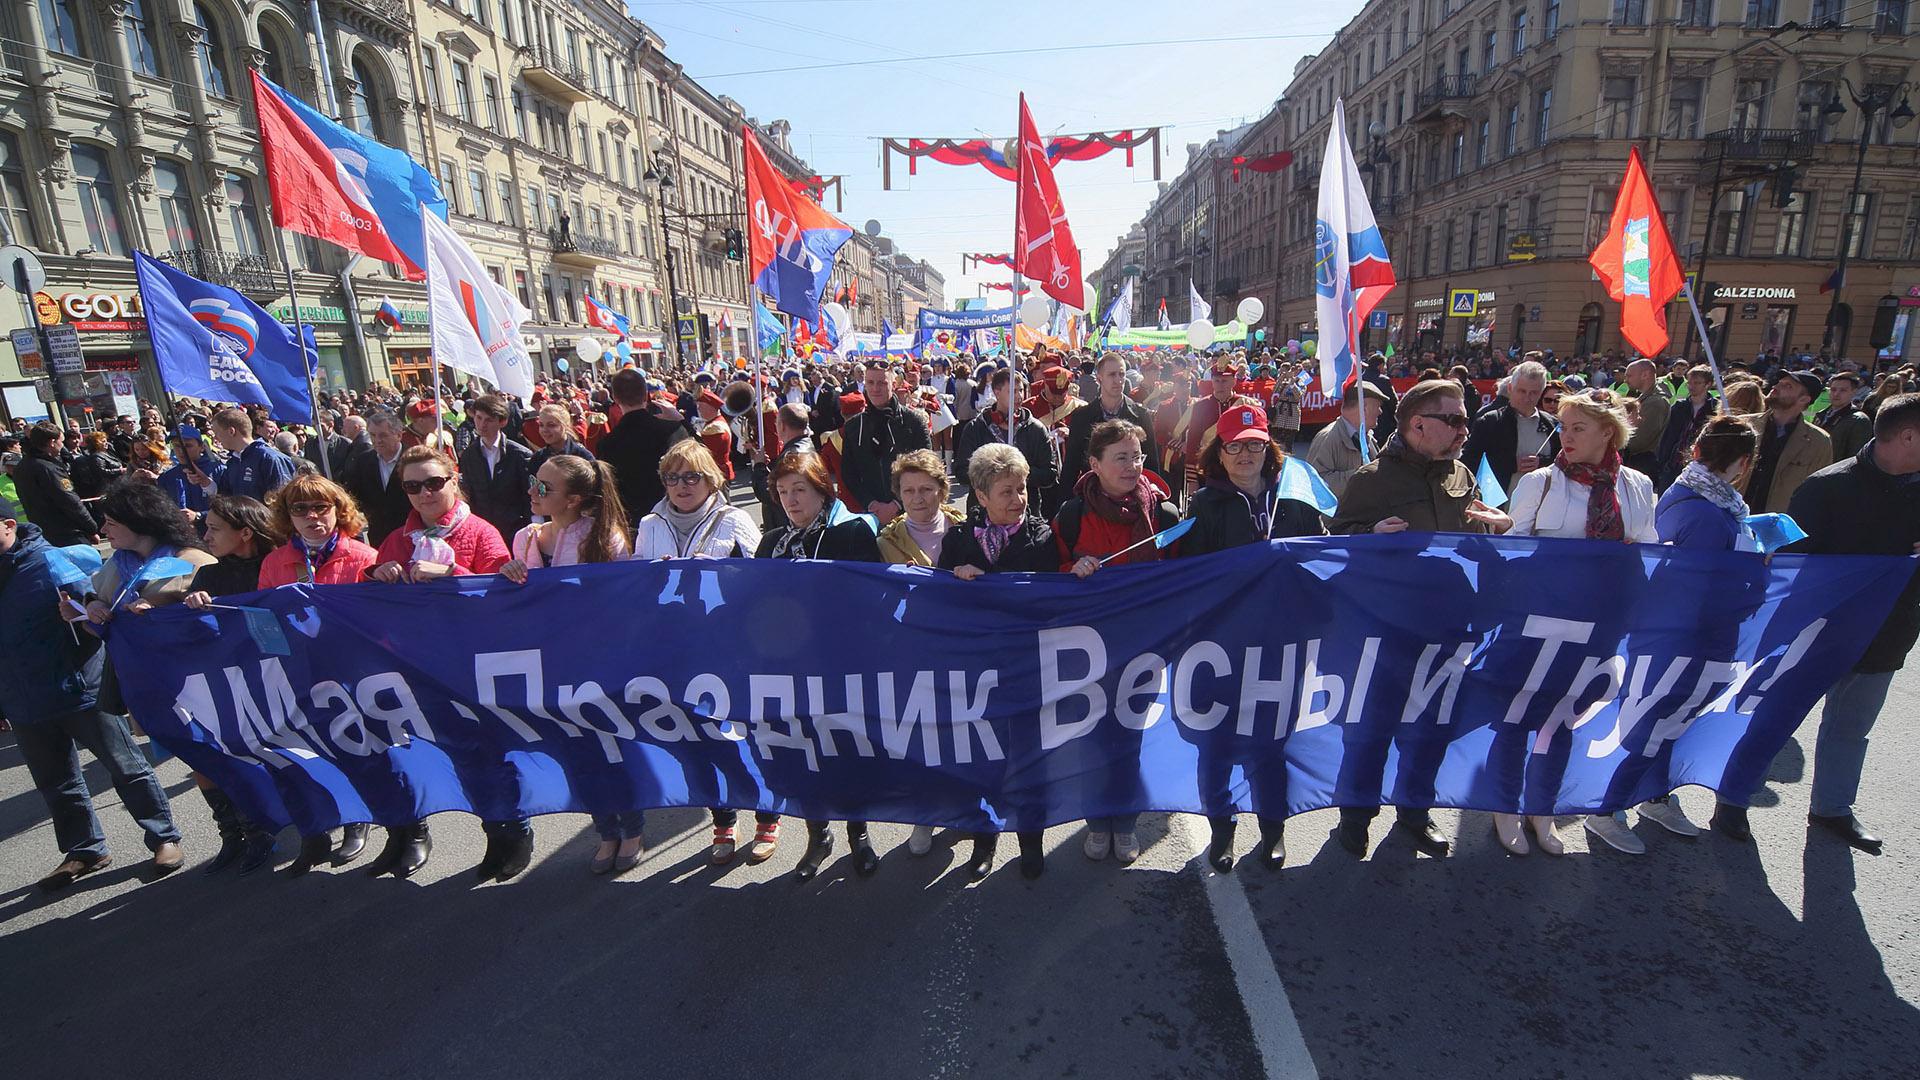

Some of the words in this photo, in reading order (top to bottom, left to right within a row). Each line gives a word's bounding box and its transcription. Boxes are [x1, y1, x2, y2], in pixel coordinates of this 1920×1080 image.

[340, 211, 372, 231] СОЮЗ
[1714, 287, 1796, 299] CALZEDONIA
[63, 294, 145, 319] GOL
[280, 305, 346, 322] СЕРБАНК
[223, 656, 436, 769] Мая
[475, 649, 1005, 773] Праздник
[1037, 624, 1382, 751] Весны
[1402, 640, 1479, 726] и
